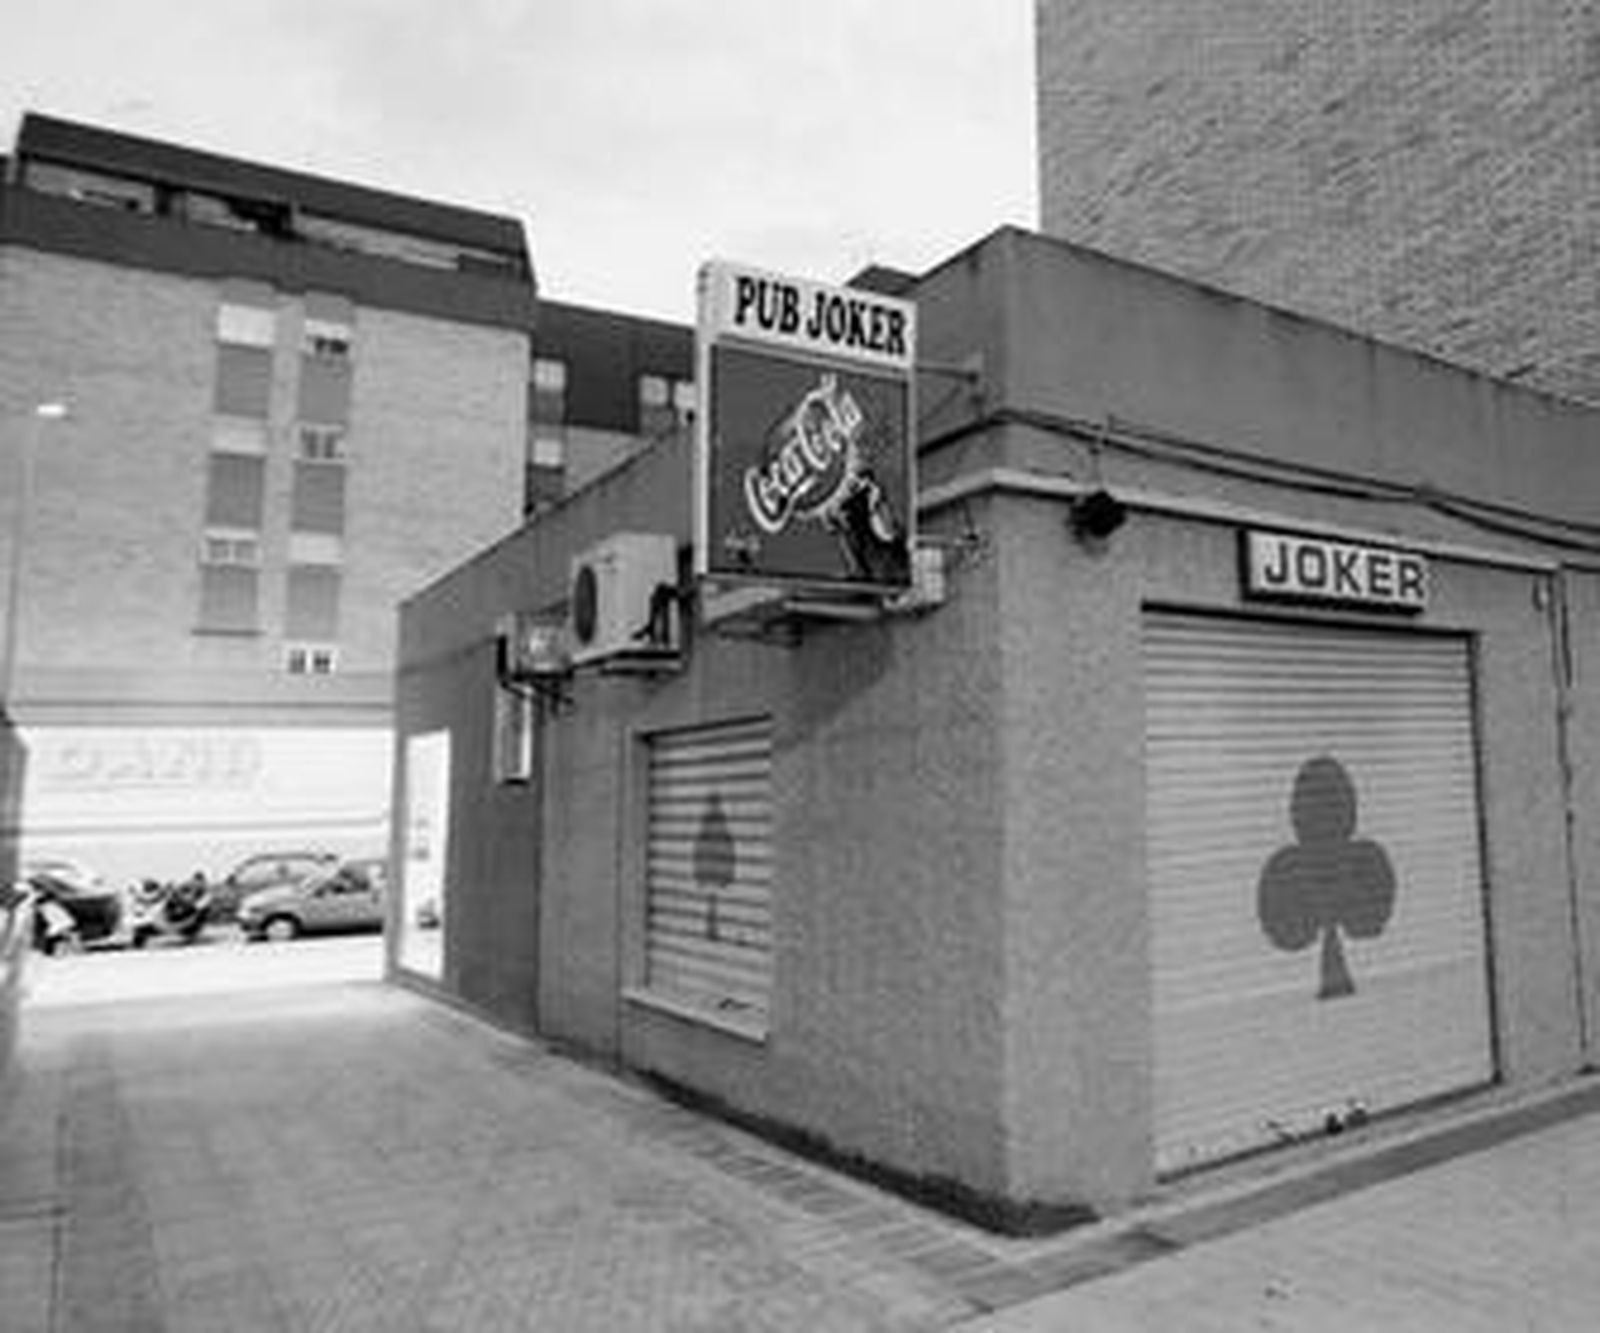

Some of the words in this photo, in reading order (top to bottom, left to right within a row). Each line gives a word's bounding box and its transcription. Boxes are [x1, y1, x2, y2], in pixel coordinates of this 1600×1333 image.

[734, 275, 800, 334] PUB
[806, 291, 906, 356] JOKER
[1264, 541, 1424, 599] JOKER
